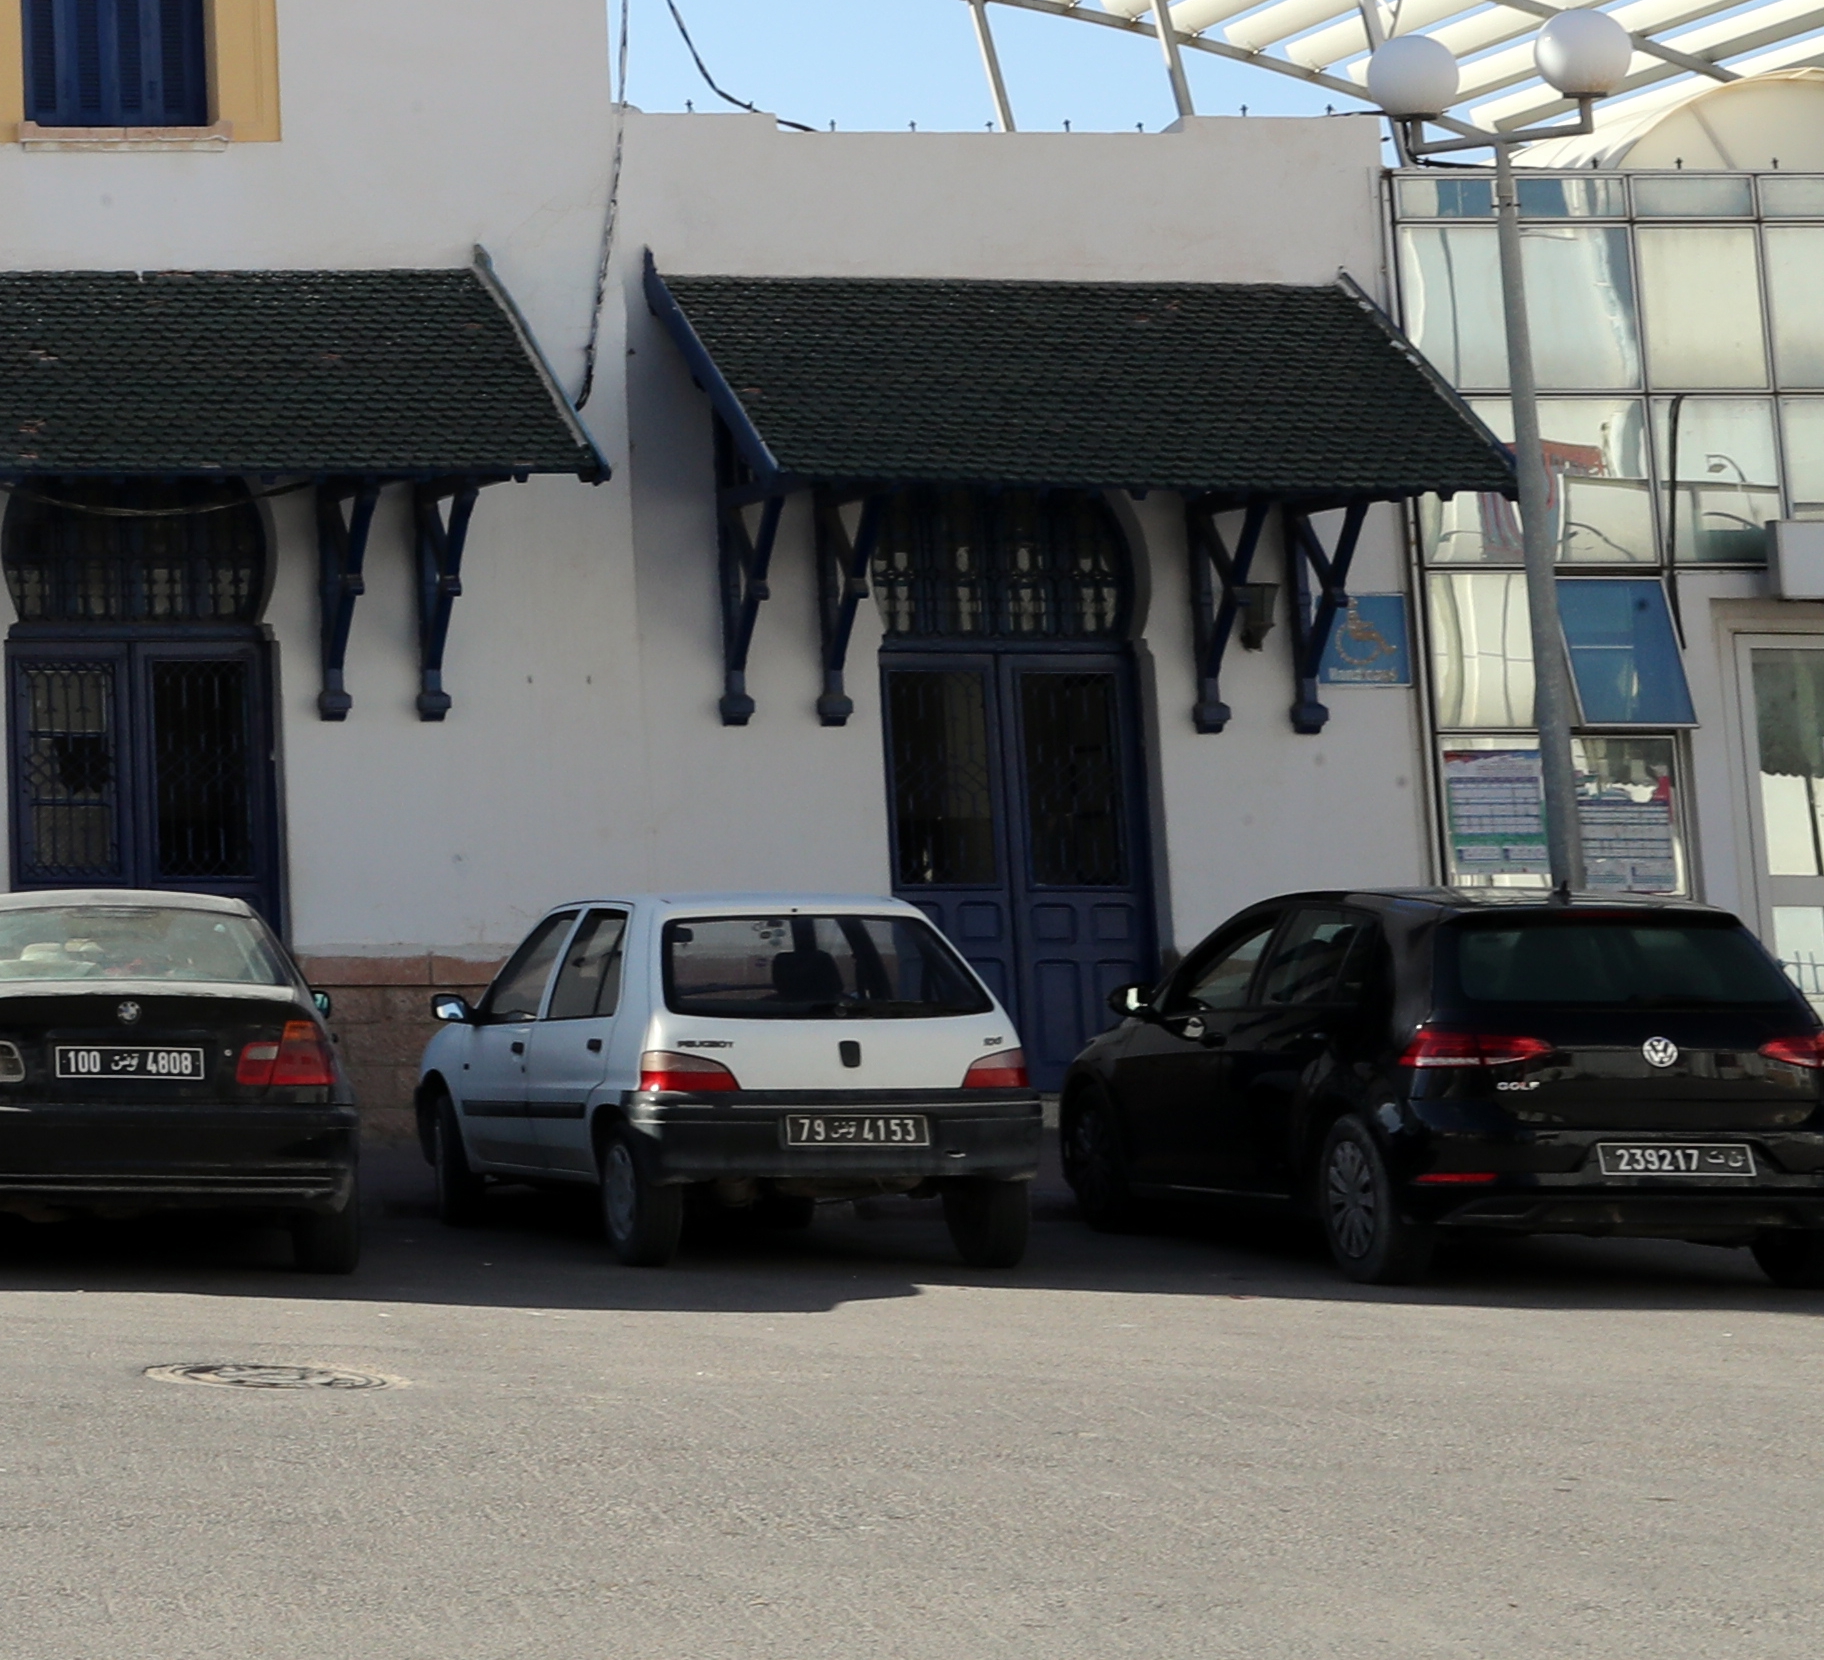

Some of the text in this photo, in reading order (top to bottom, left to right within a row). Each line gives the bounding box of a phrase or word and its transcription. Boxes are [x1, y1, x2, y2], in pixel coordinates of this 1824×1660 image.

[67, 1051, 193, 1074] 100 تونس 4808
[1496, 1081, 1541, 1091] GOLF
[798, 1119, 916, 1141] 79 تونس 4153
[1616, 1149, 1699, 1171] 239217
